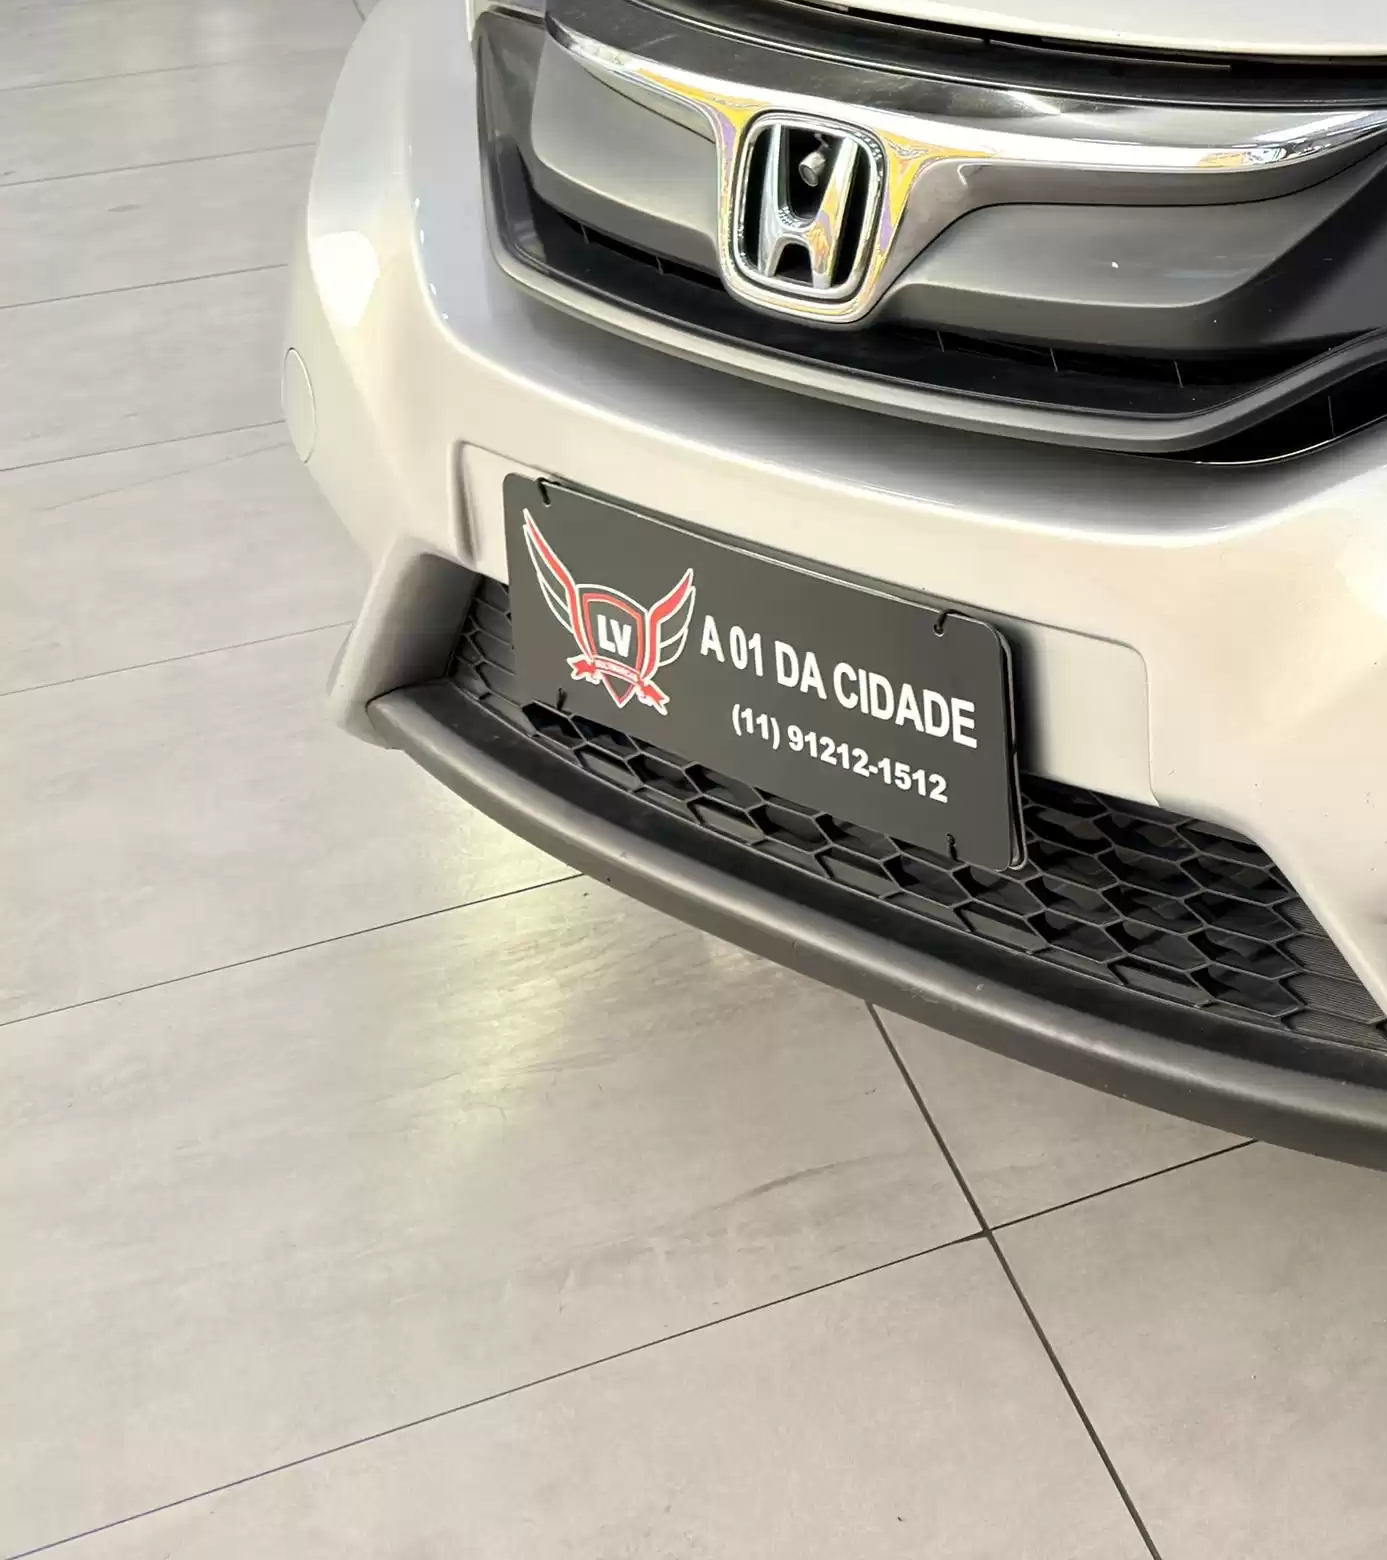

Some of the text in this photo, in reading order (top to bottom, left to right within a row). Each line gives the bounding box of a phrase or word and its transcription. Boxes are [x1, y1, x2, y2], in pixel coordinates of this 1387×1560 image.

[596, 613, 632, 658] LV
[699, 614, 978, 749] A 01 DA CIDADE
[731, 703, 949, 804] (11) 91212-1512
